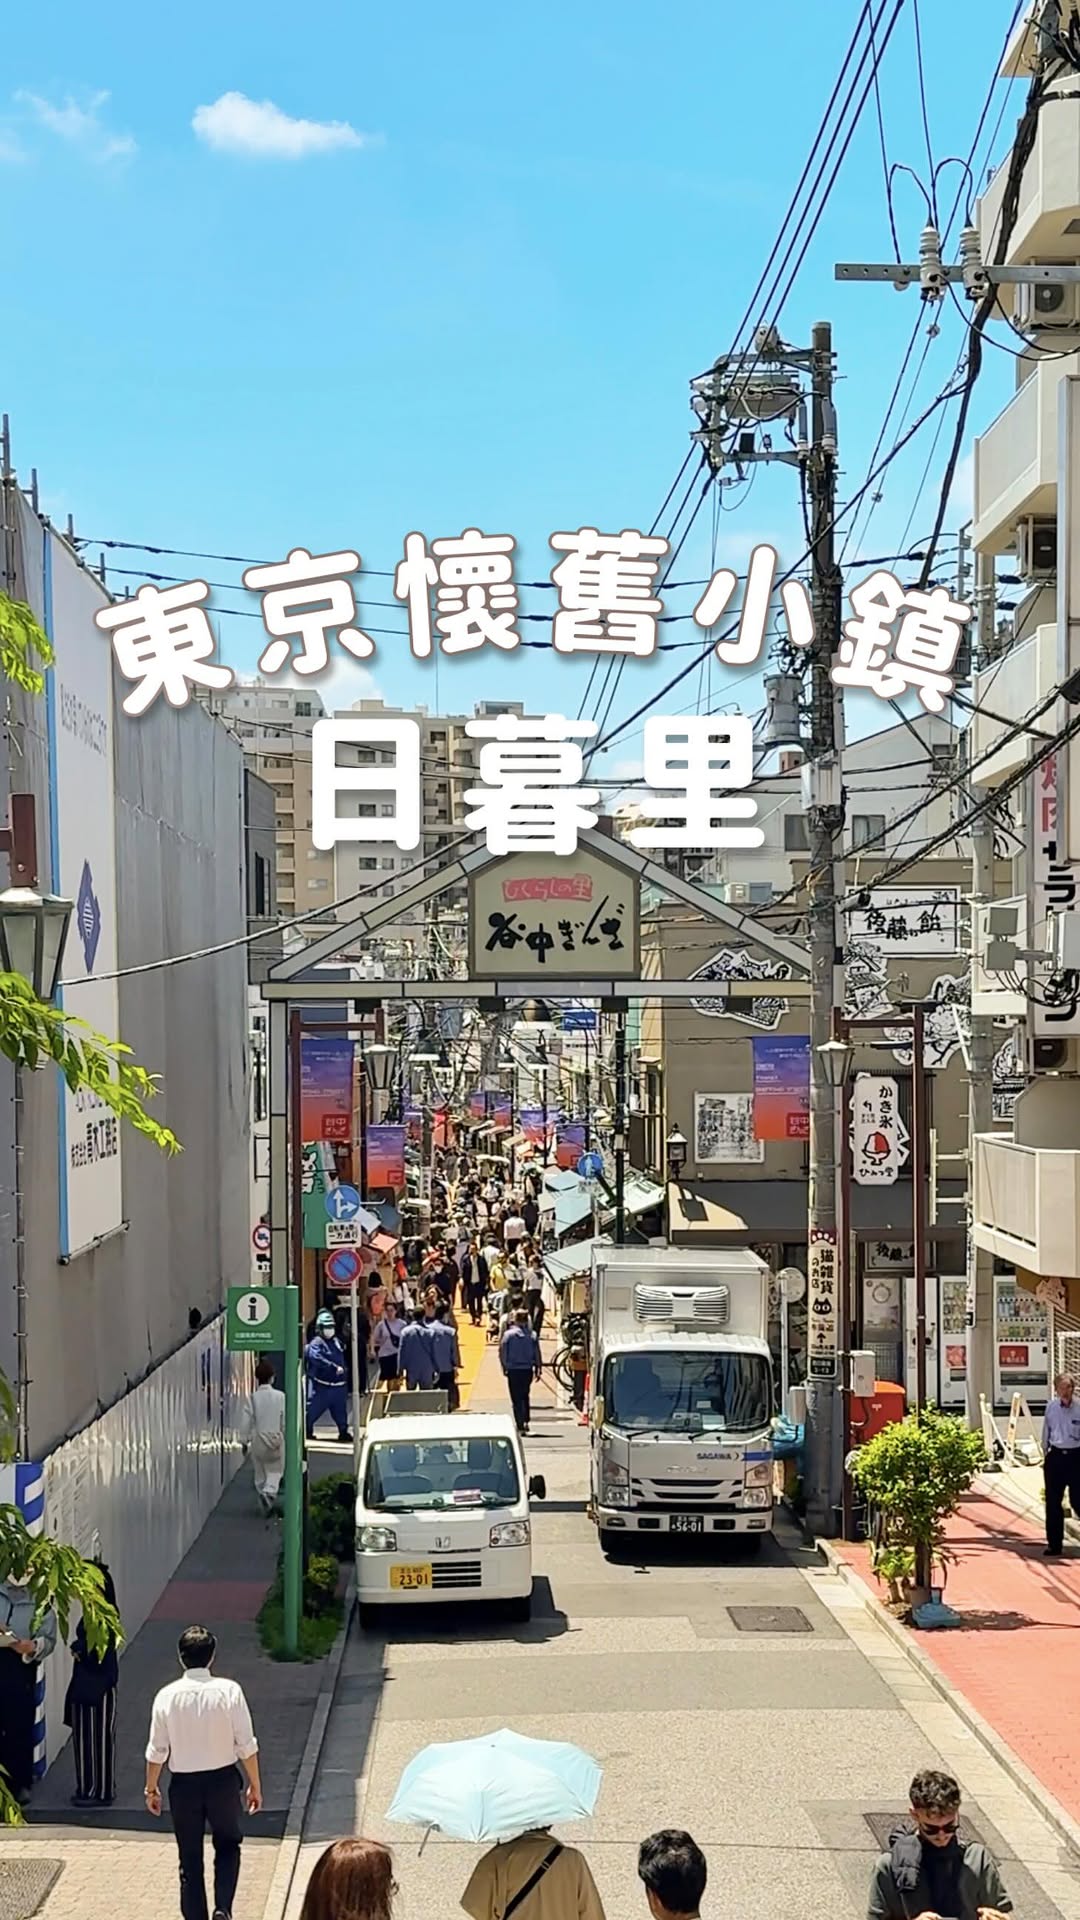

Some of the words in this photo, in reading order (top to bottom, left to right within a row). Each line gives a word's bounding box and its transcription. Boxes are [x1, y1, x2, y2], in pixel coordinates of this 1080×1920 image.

[485, 895, 625, 963] 谷中ぎんざ
[879, 1085, 893, 1129] かき氷
[329, 1231, 358, 1239] 一方通行
[820, 1249, 834, 1295] 猫雑貨
[676, 1521, 702, 1531] 56-01
[399, 1573, 428, 1585] 23-01
